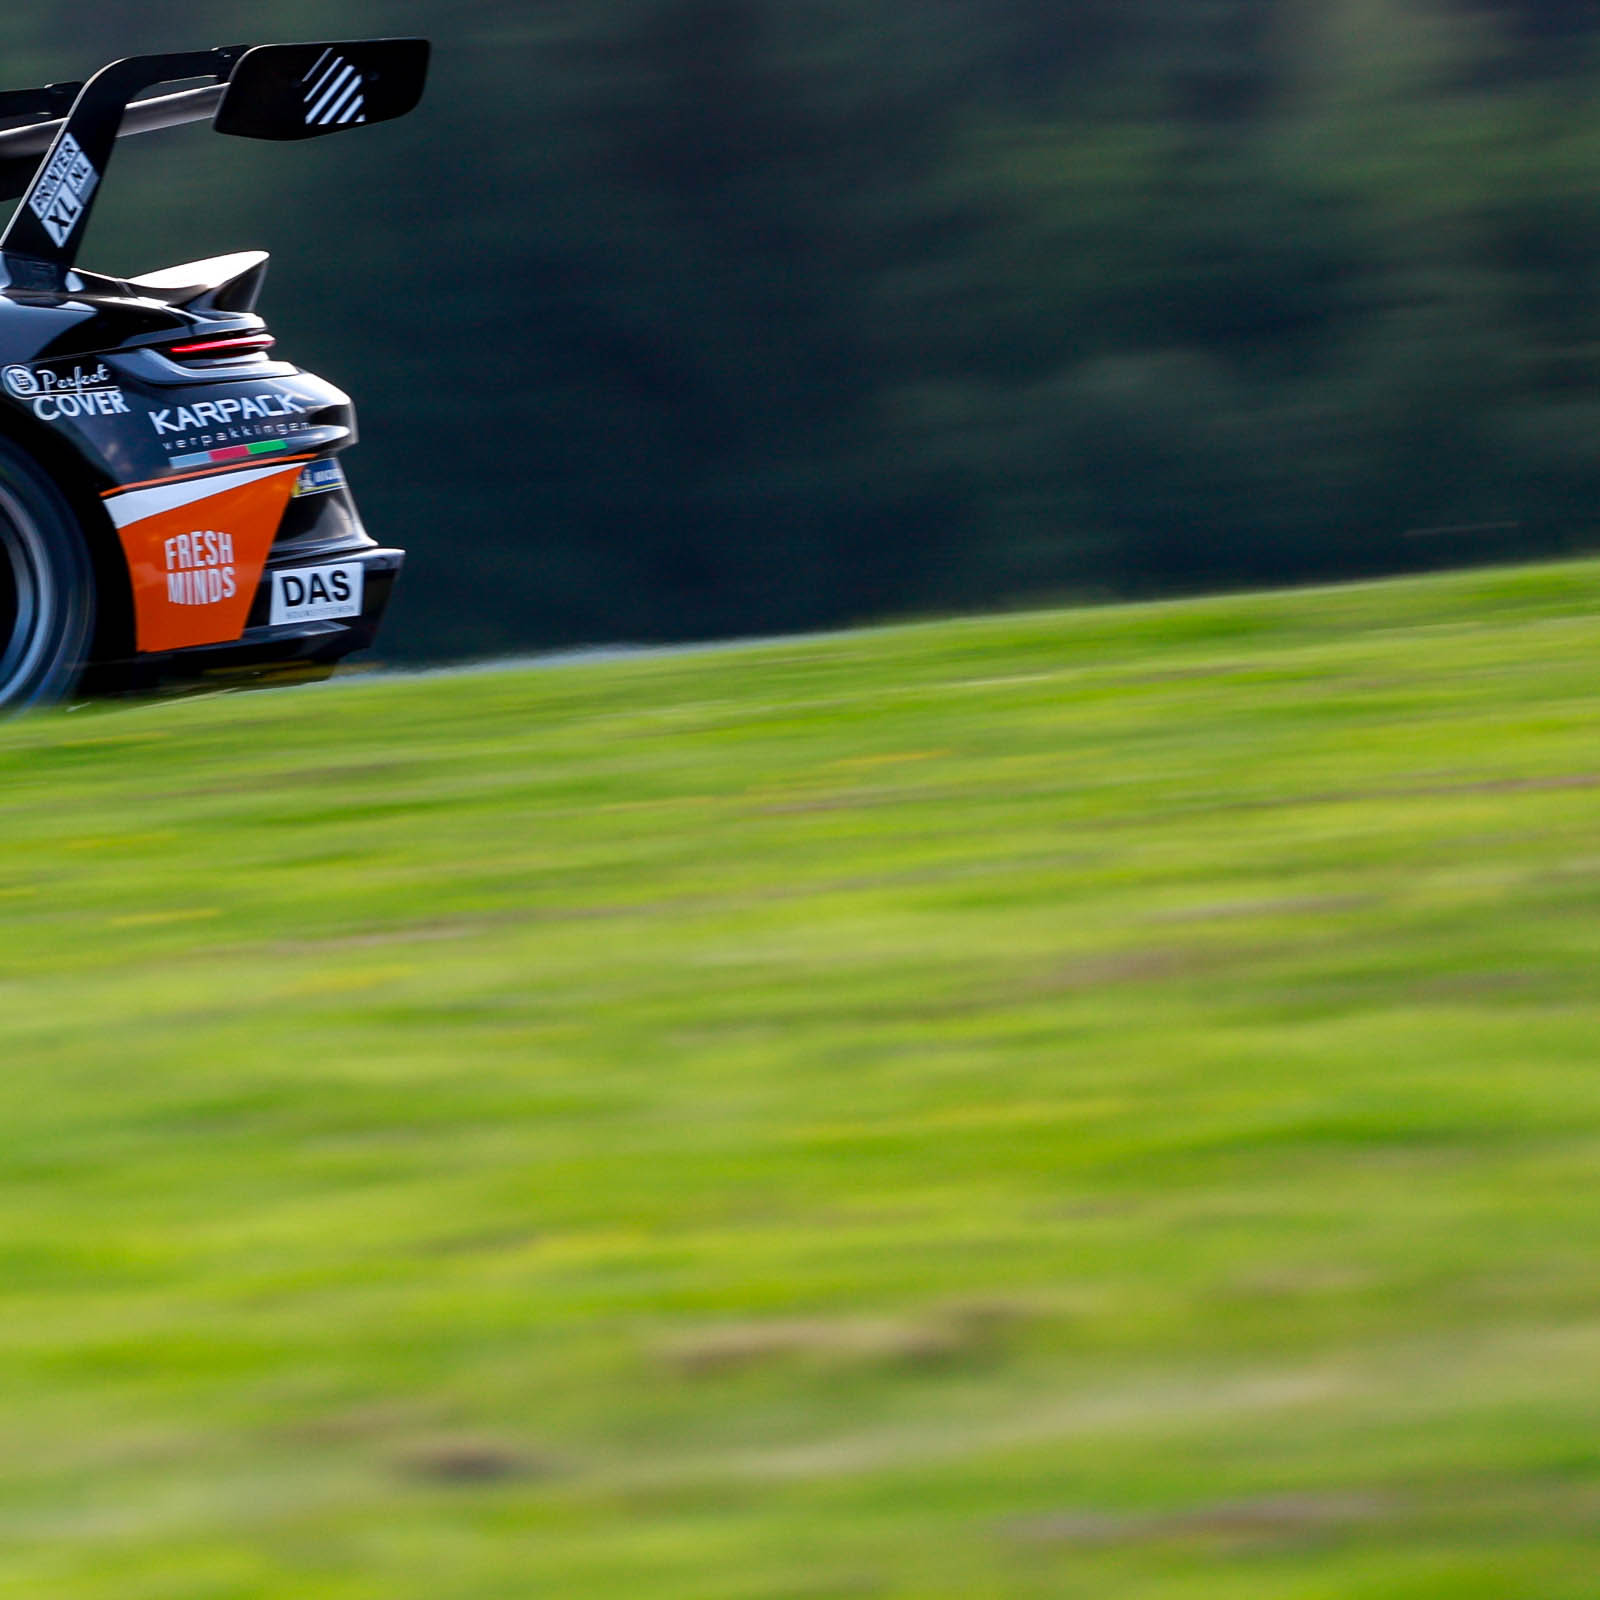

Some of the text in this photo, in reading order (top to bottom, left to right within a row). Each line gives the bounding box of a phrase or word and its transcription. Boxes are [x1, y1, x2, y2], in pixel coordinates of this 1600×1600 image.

[35, 141, 76, 213] PRINTER
[47, 197, 78, 239] XL
[36, 364, 110, 394] Perfect
[33, 390, 131, 421] COVER
[148, 392, 306, 435] KARPACK
[164, 529, 235, 570] FRESH
[167, 566, 237, 605] MINDS
[280, 570, 351, 608] DAS
